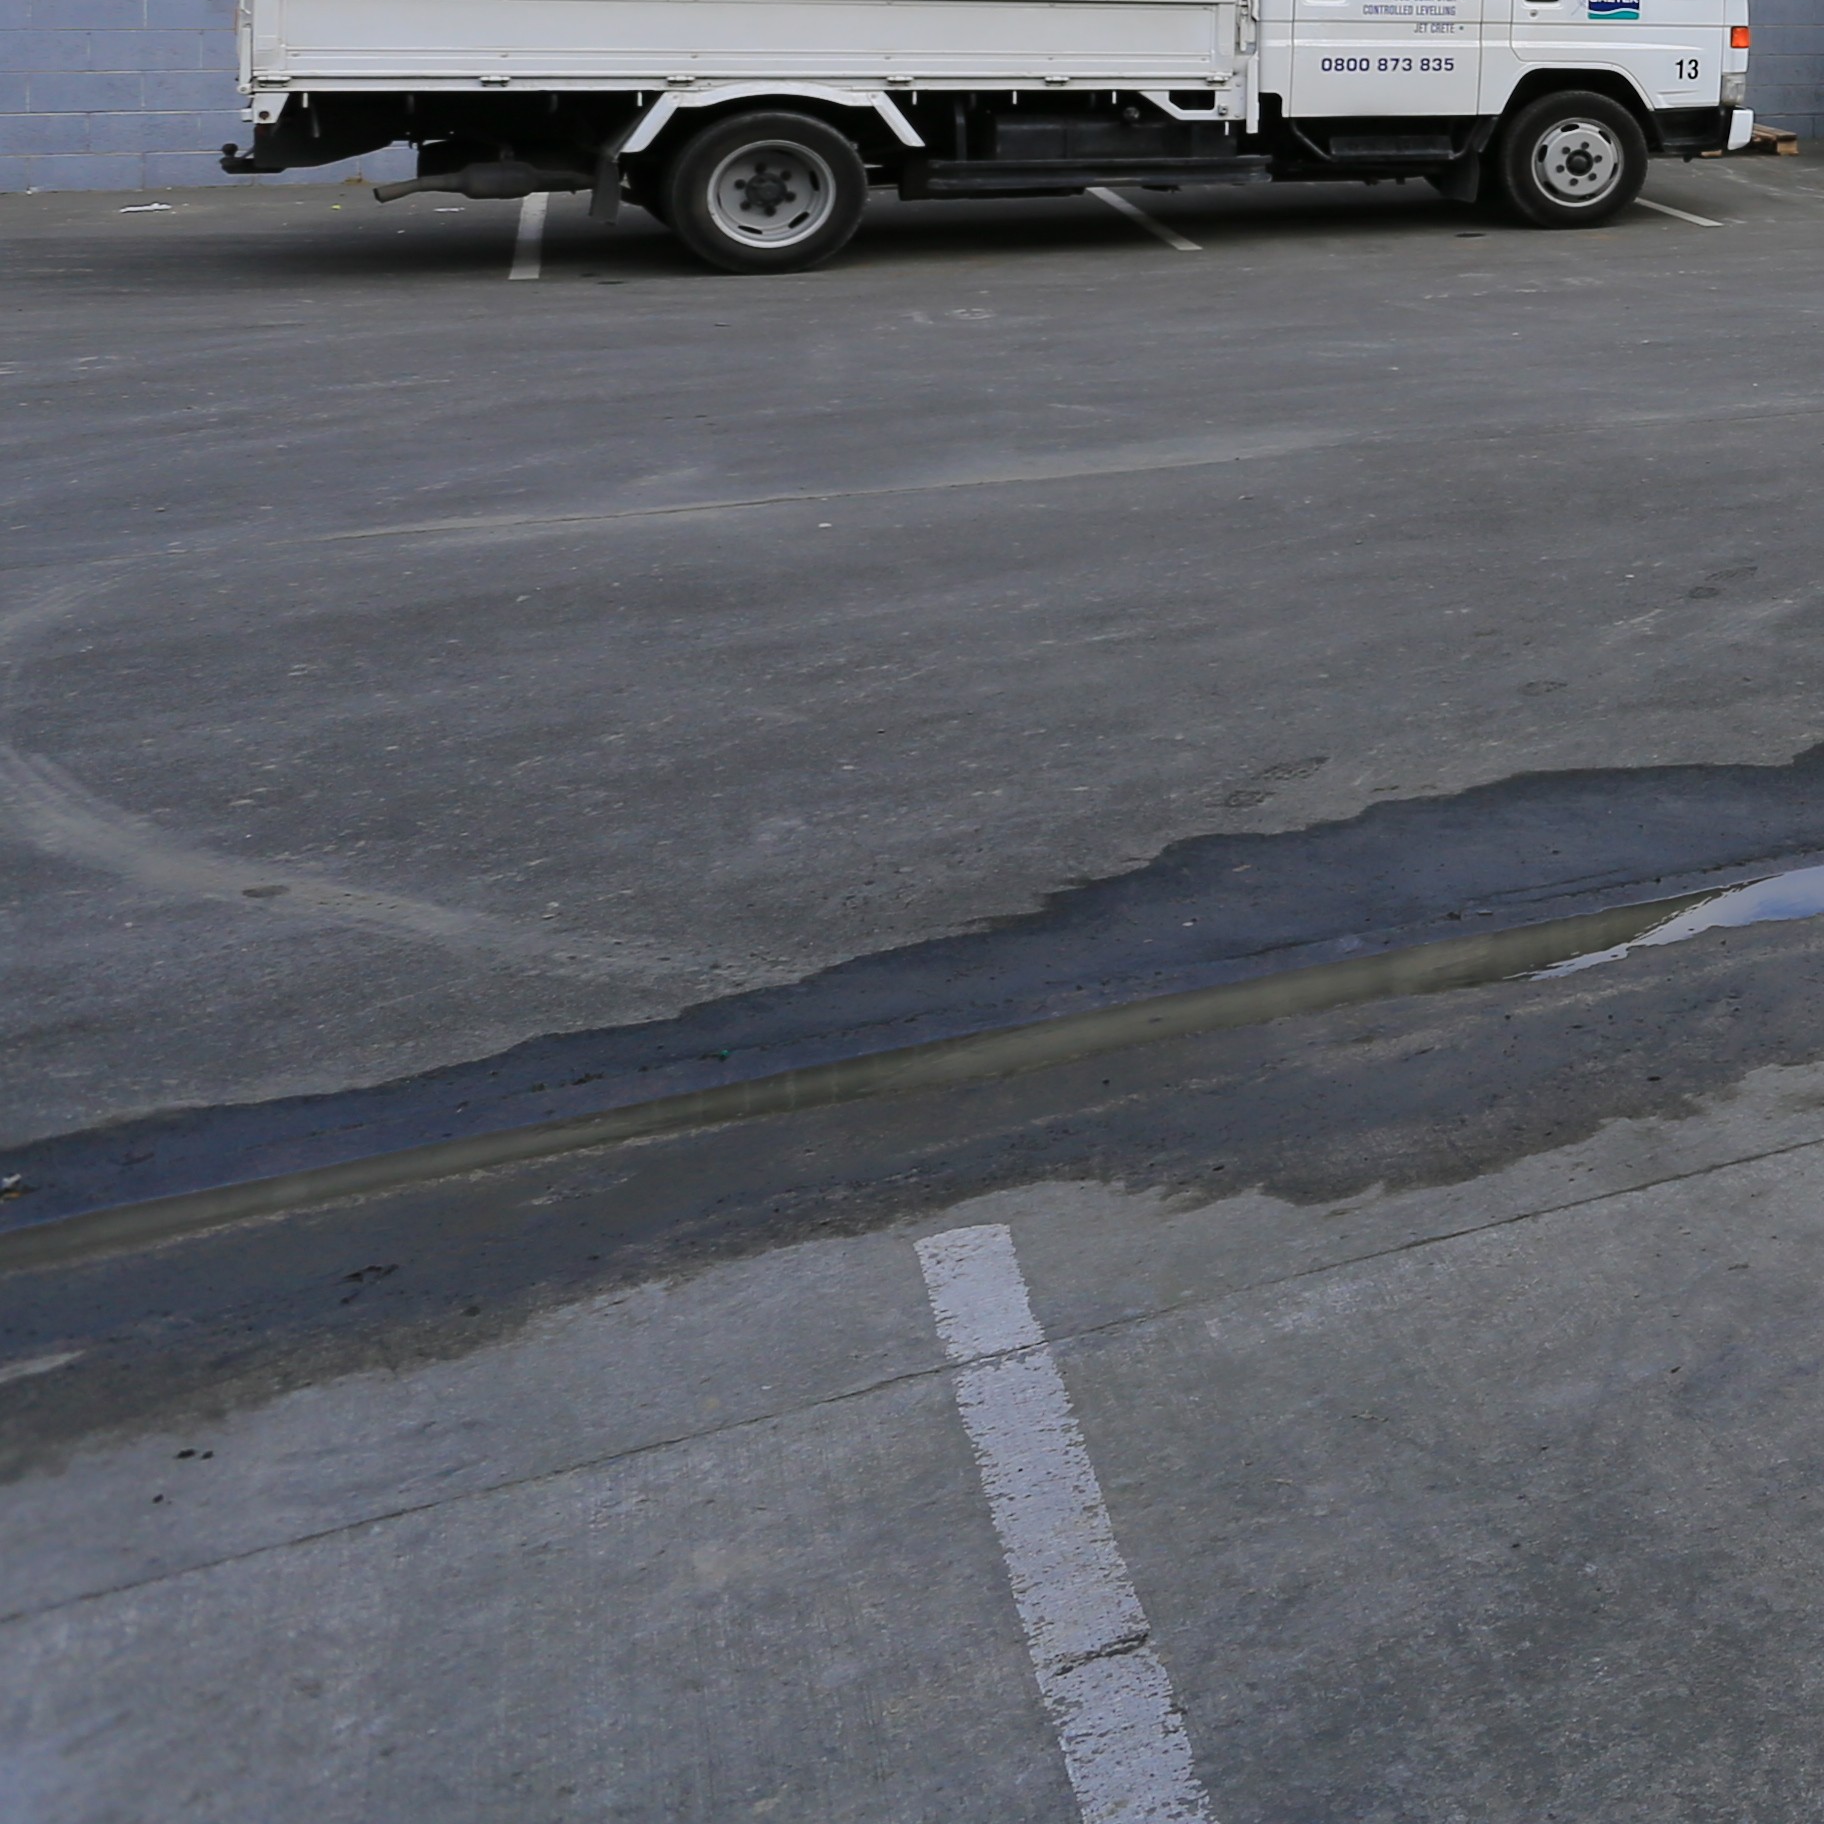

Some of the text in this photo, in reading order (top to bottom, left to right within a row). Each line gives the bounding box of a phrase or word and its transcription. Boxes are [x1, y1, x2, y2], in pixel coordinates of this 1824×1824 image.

[1363, 5, 1456, 16] CONTROLLED LEVELLING
[1413, 22, 1455, 34] JET CRETE
[1321, 58, 1455, 72] 0800 873 835
[1675, 59, 1699, 80] 13
